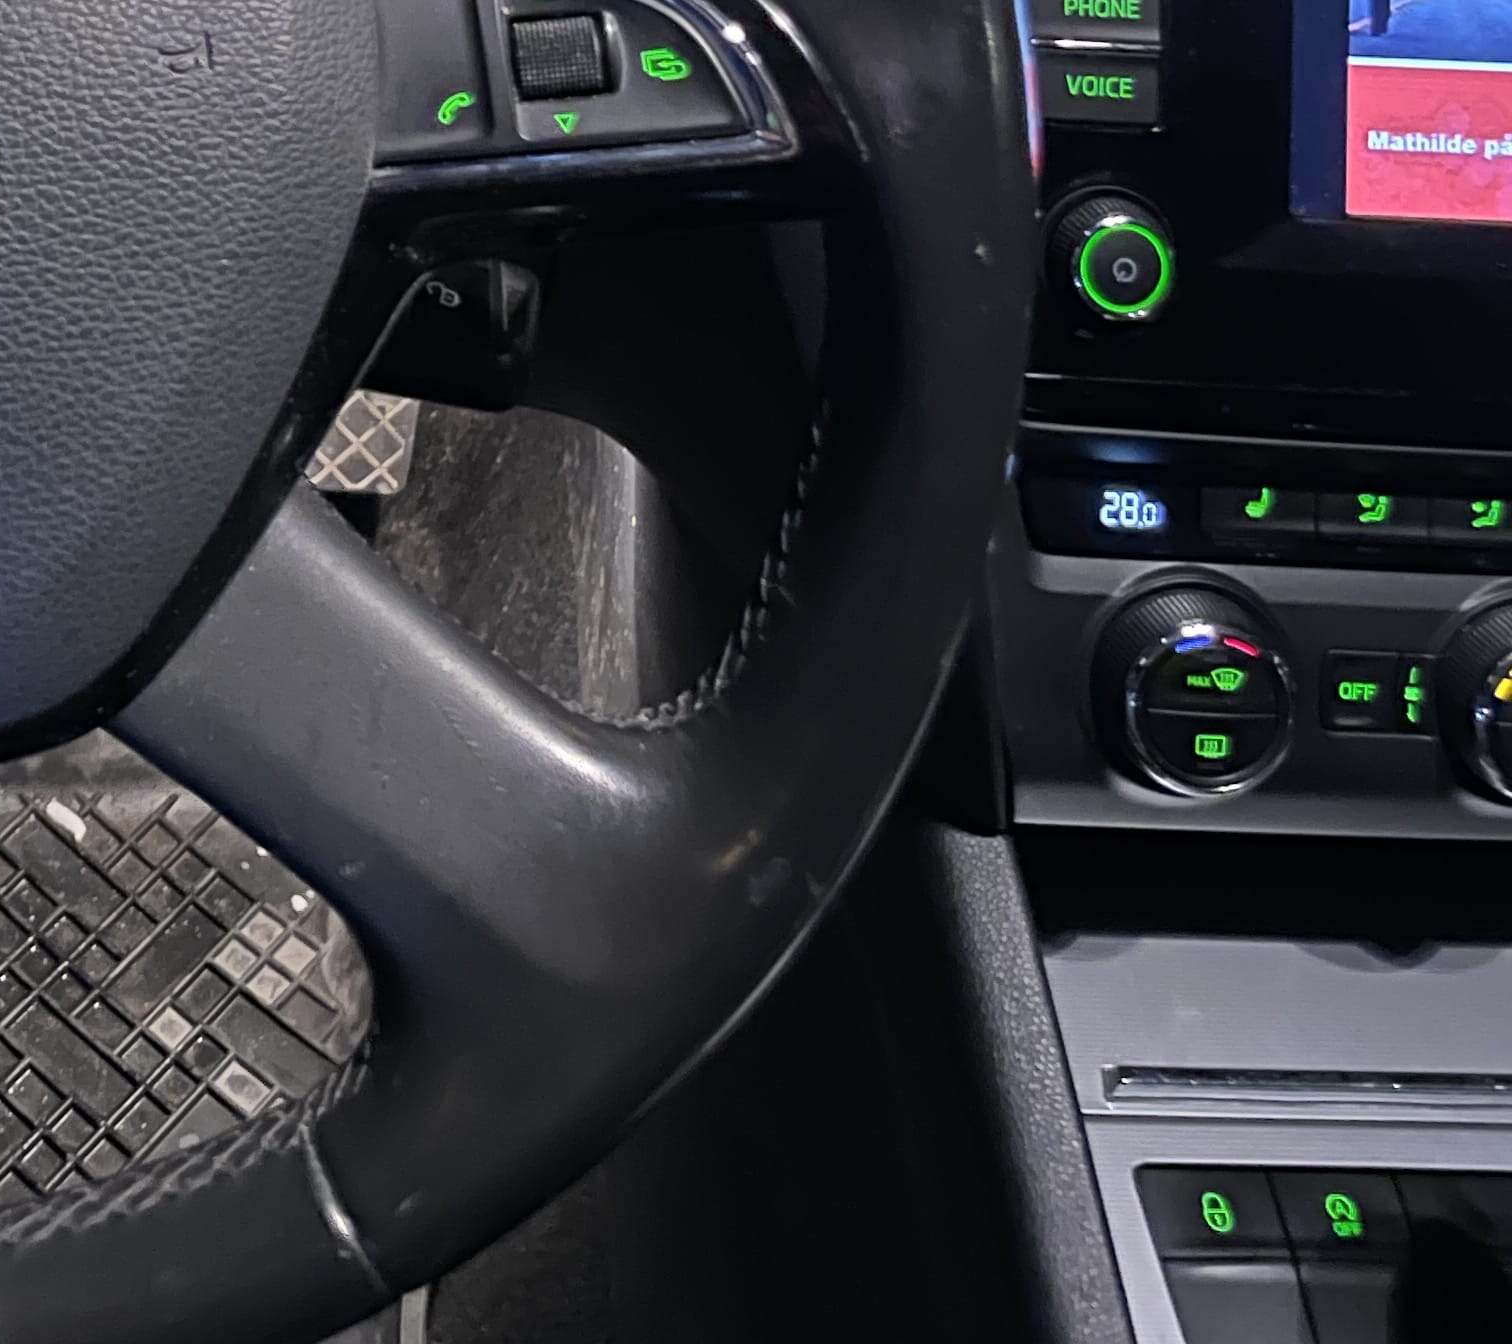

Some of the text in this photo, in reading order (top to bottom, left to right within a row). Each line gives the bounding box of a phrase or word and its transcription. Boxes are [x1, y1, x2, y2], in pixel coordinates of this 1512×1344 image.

[1065, 74, 1135, 99] VOICE
[1368, 130, 1477, 154] Mathilde
[1099, 490, 1158, 528] 28.0
[1338, 681, 1378, 701] OFF
